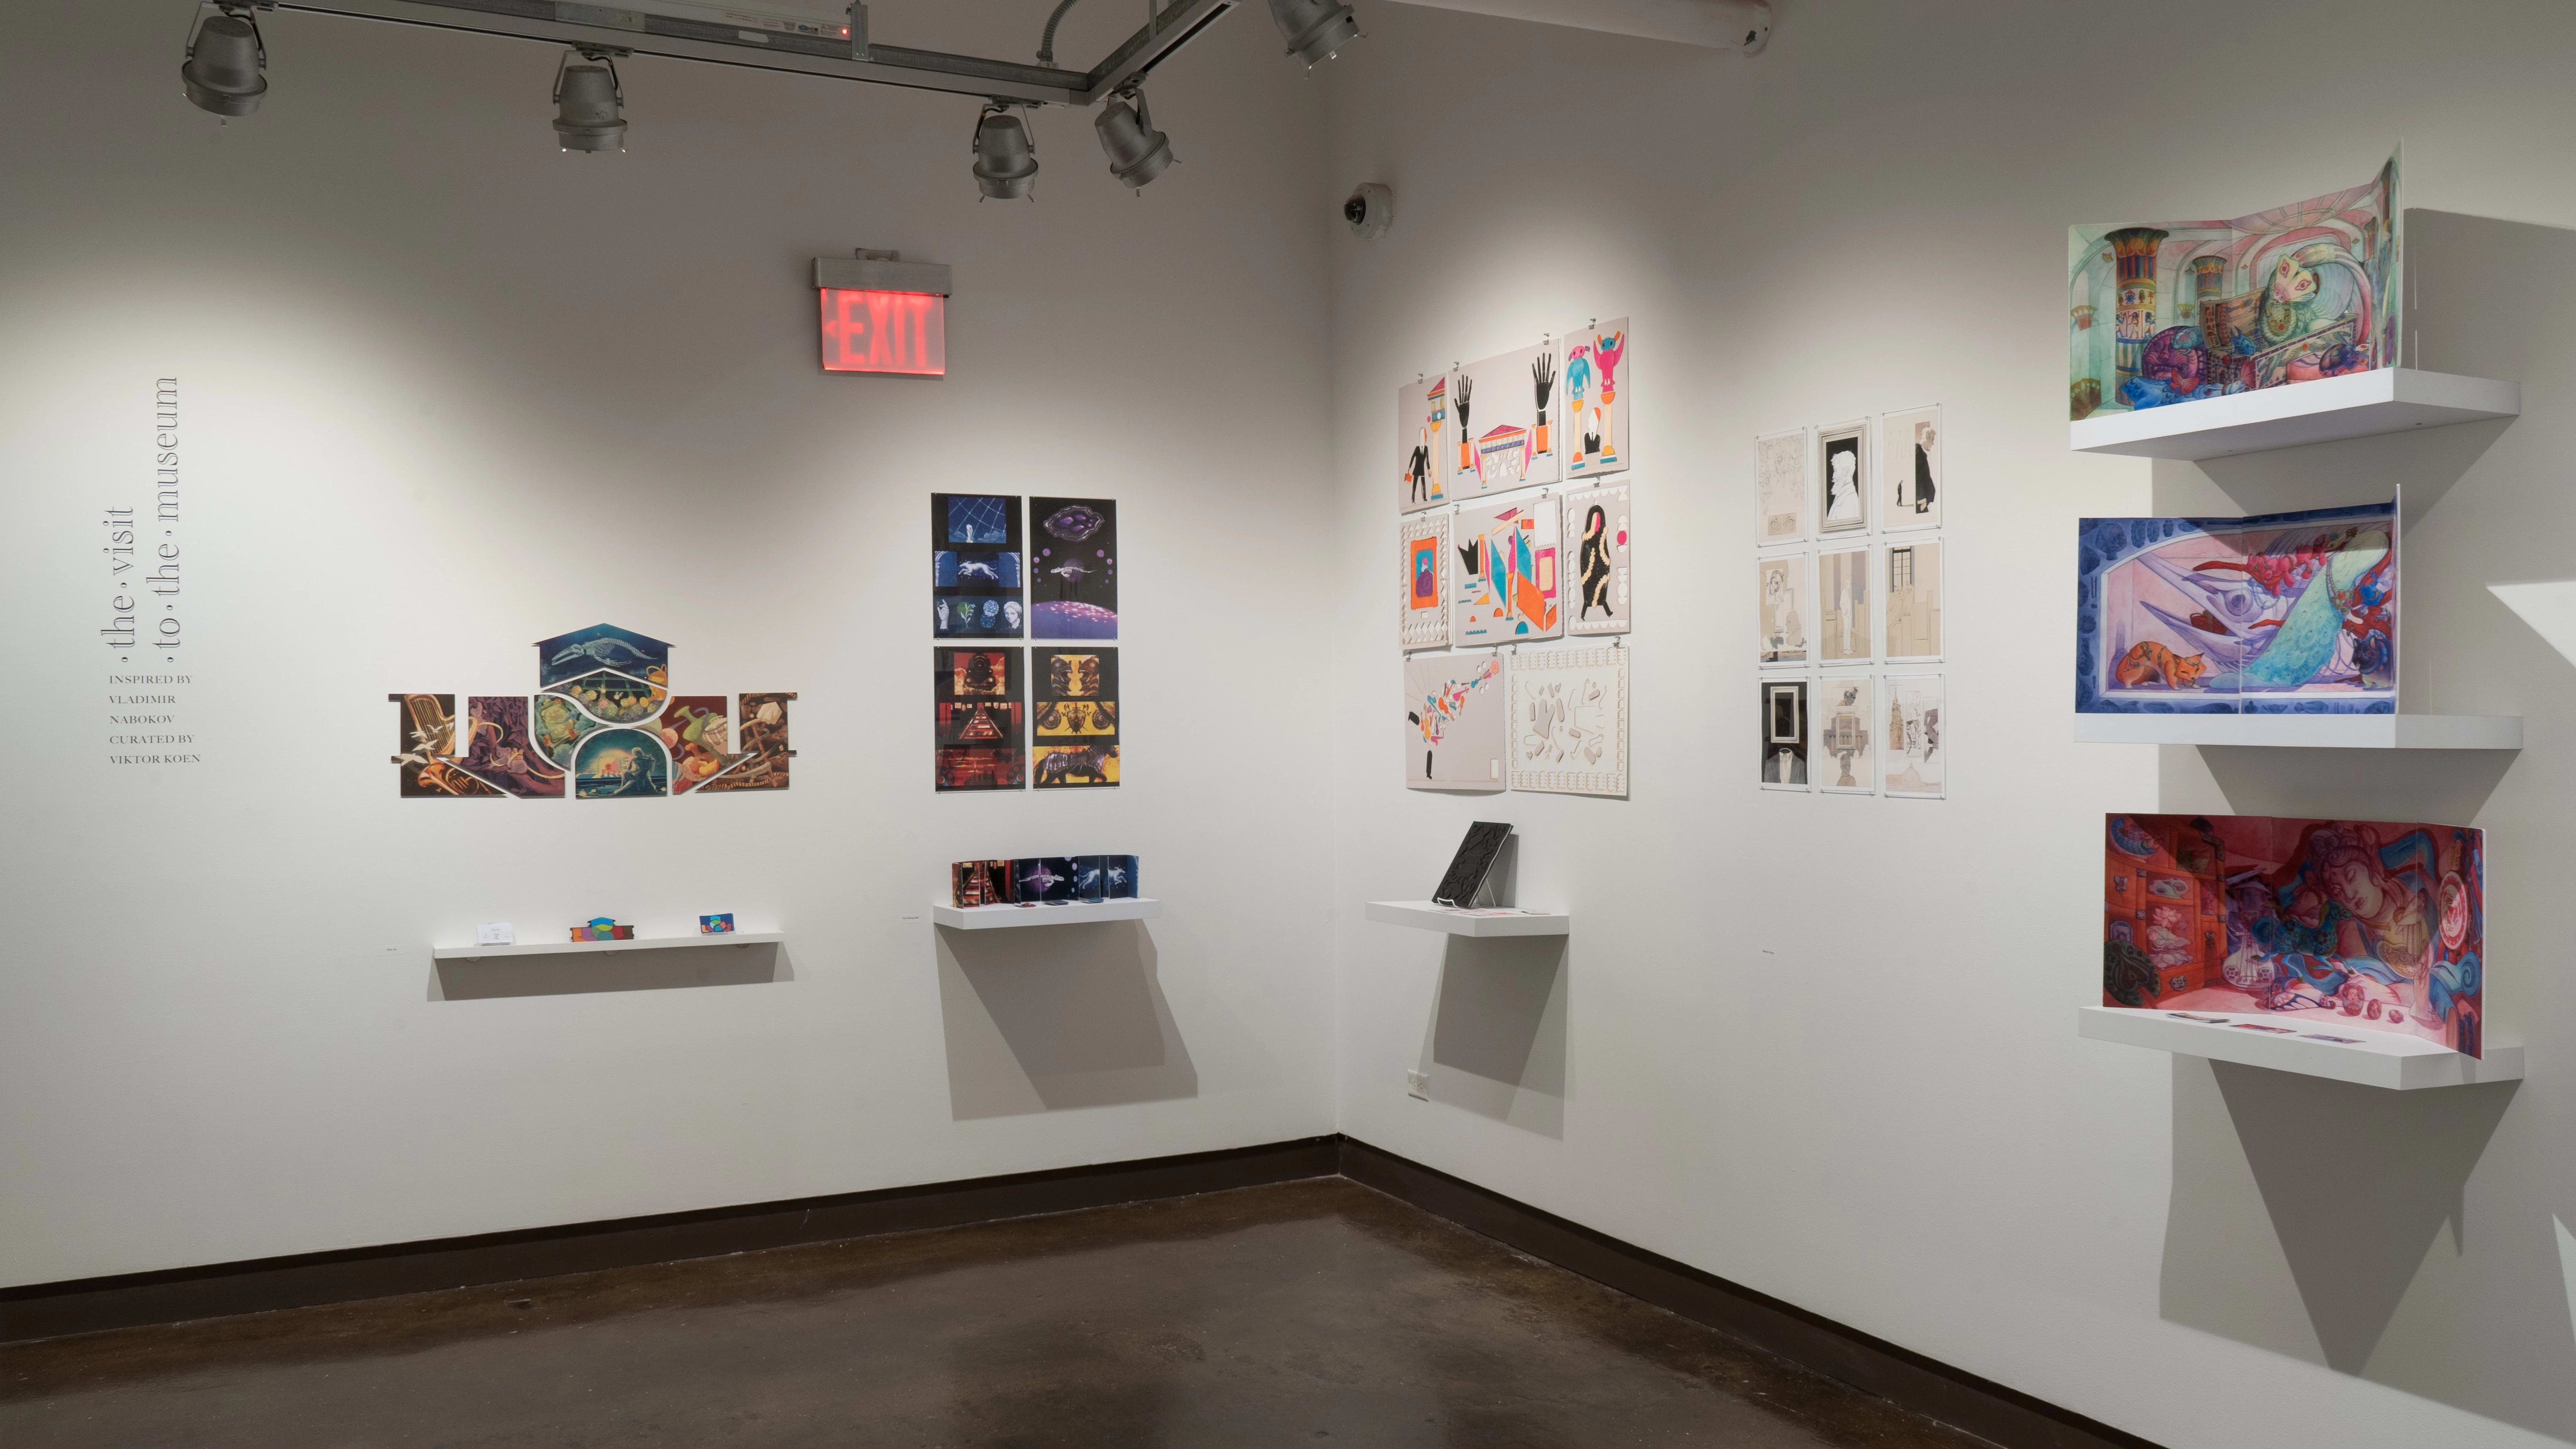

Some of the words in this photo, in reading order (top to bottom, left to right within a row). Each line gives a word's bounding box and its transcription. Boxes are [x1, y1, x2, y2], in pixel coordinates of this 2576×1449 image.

[838, 290, 933, 366] EXIT
[155, 376, 179, 522] museum
[102, 506, 134, 576] visit
[145, 543, 180, 597] the
[100, 595, 136, 649] the
[151, 618, 181, 649] to
[109, 675, 173, 684] INSPIRED
[177, 675, 193, 684] BY
[109, 695, 176, 704] VLADIMIR
[109, 715, 175, 724] NABOKOV
[109, 735, 175, 744] CURATED
[178, 734, 194, 743] BY
[109, 755, 161, 764] VIKTOR
[164, 754, 201, 763] KOEN
